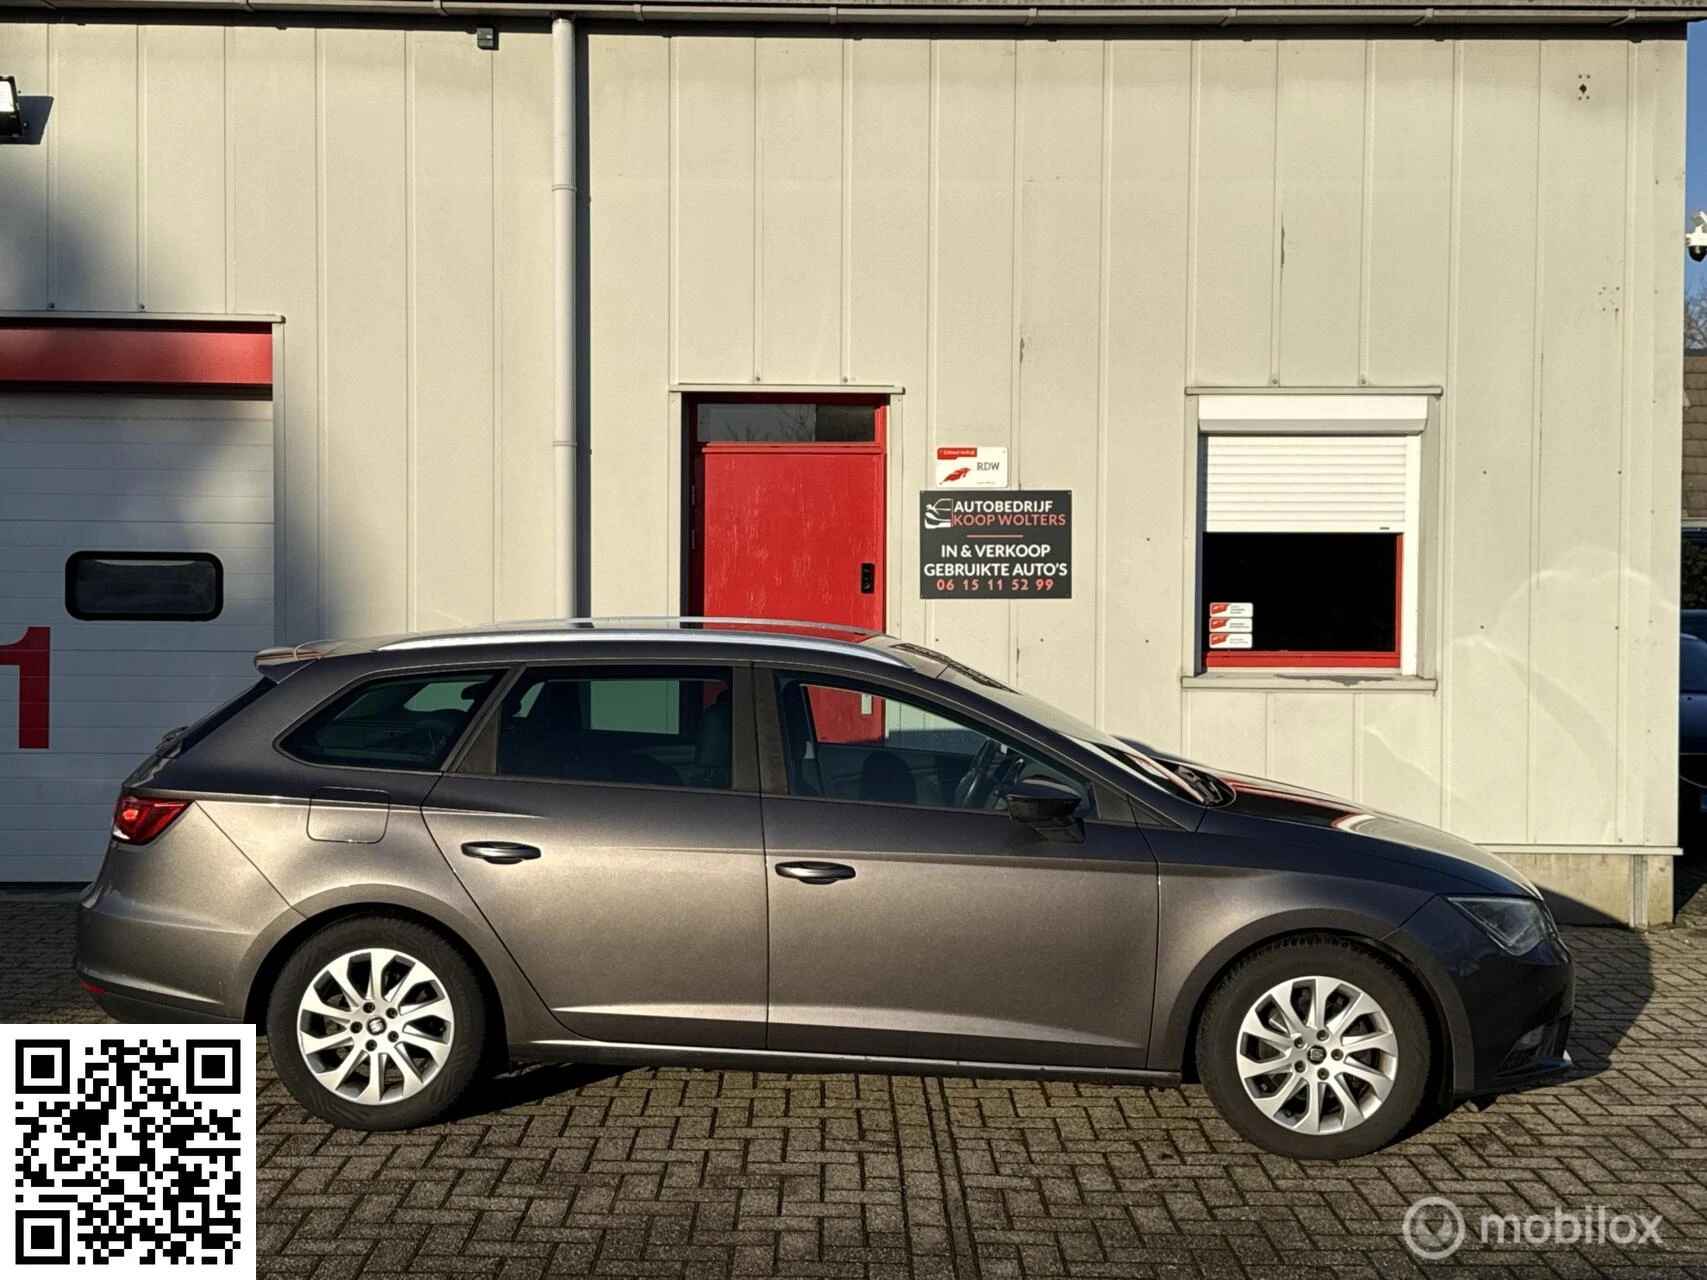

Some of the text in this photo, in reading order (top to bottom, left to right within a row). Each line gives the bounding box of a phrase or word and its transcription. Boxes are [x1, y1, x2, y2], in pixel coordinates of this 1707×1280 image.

[976, 462, 1000, 471] RDW
[953, 500, 1053, 513] AUTOBEDRIJF
[953, 514, 1066, 526] KOOP WOLTERS
[941, 544, 1051, 558] IN & VERKOOP
[924, 563, 1068, 576] GEBRUIKTE AUTO'S
[936, 579, 1054, 591] 06 15 11 52 99
[0, 626, 51, 749] 1
